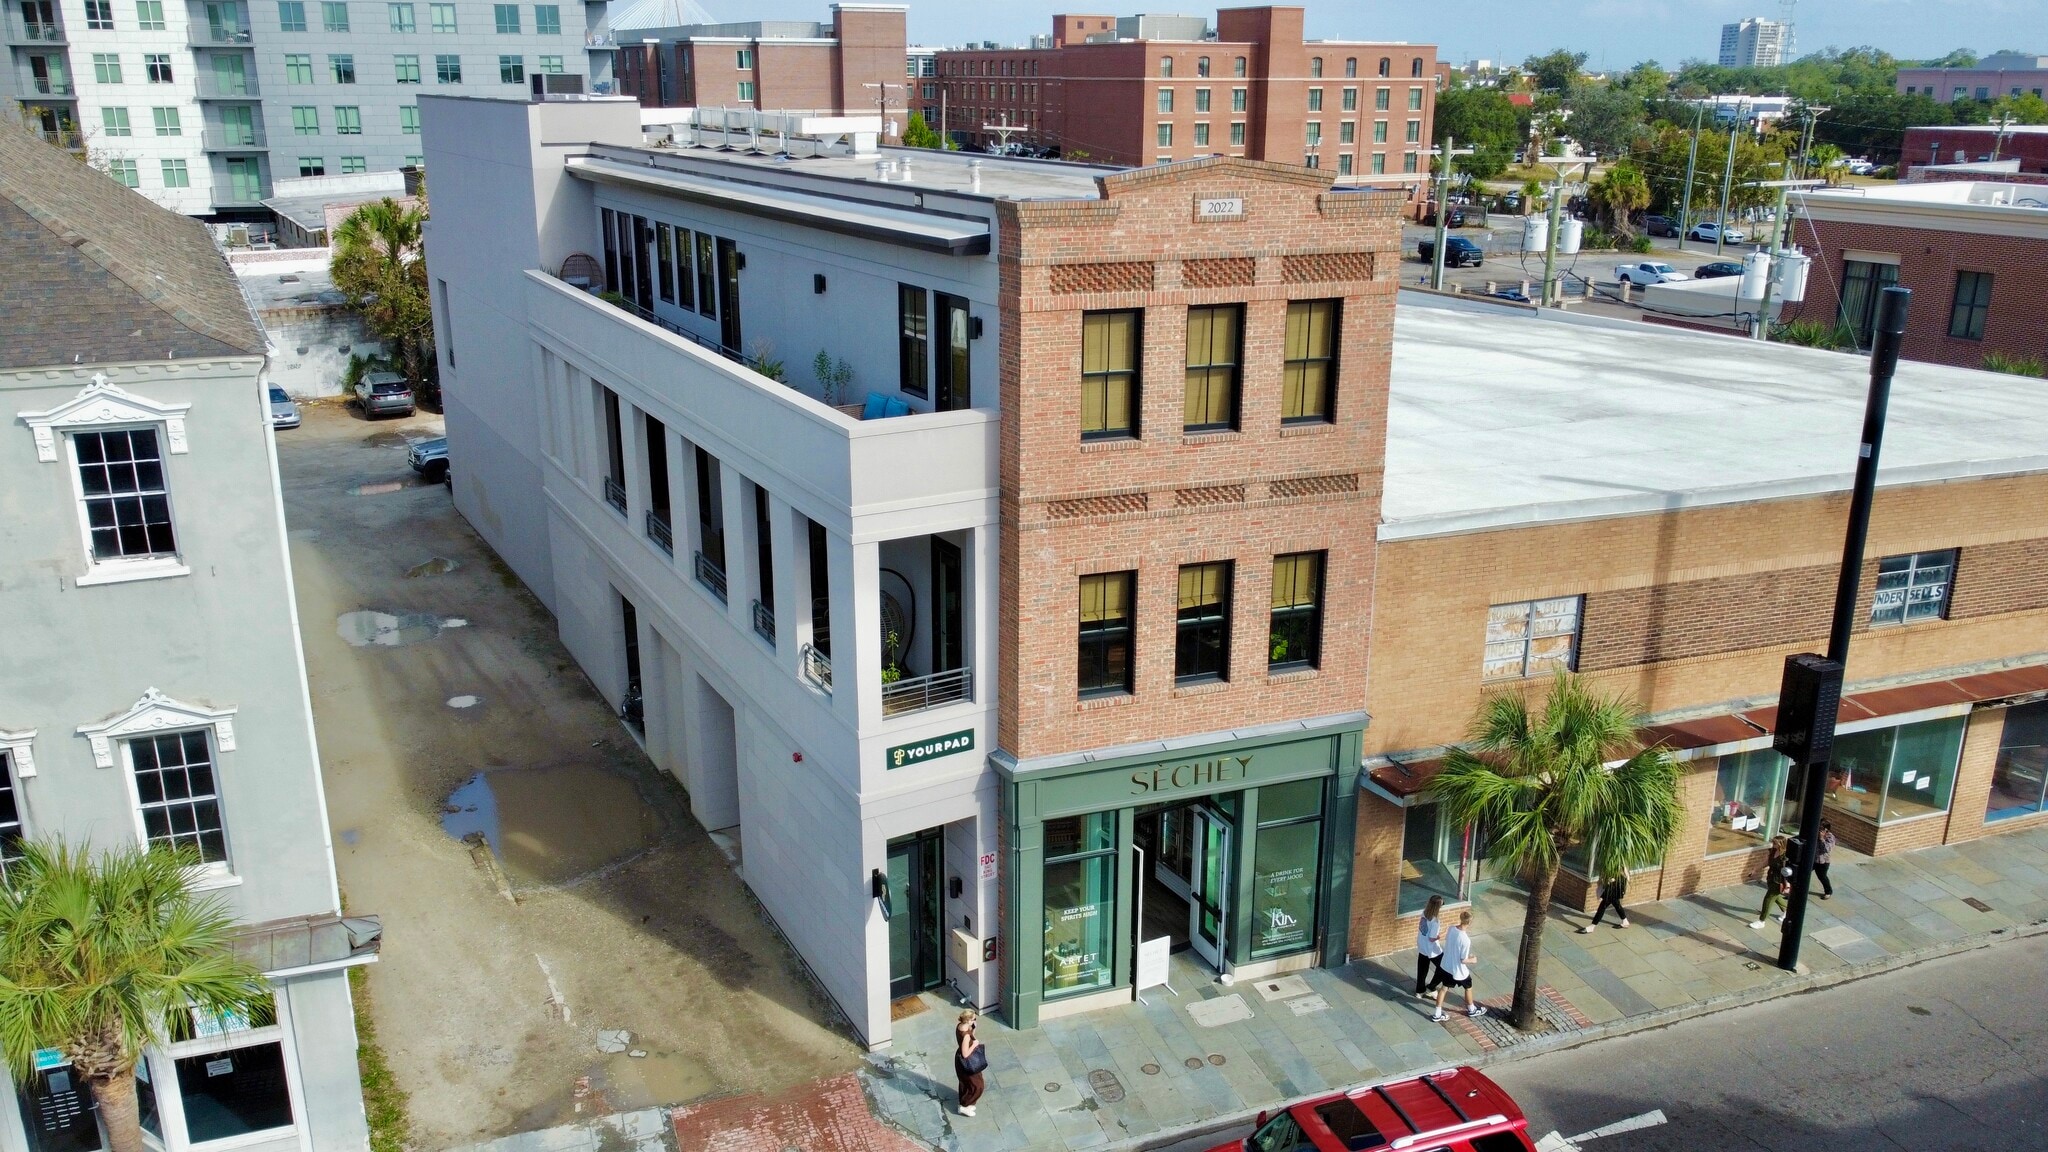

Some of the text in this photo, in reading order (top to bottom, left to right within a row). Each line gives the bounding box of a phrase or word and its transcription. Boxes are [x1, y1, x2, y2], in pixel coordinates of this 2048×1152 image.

[1208, 201, 1234, 213] 2022
[1909, 585, 1943, 600] SELLS
[907, 736, 970, 759] YOURPAD
[1130, 755, 1254, 795] SÈCHEY
[980, 853, 995, 866] FDC
[1063, 904, 1095, 915] KEEP YOUR
[1059, 952, 1099, 967] ARTET
